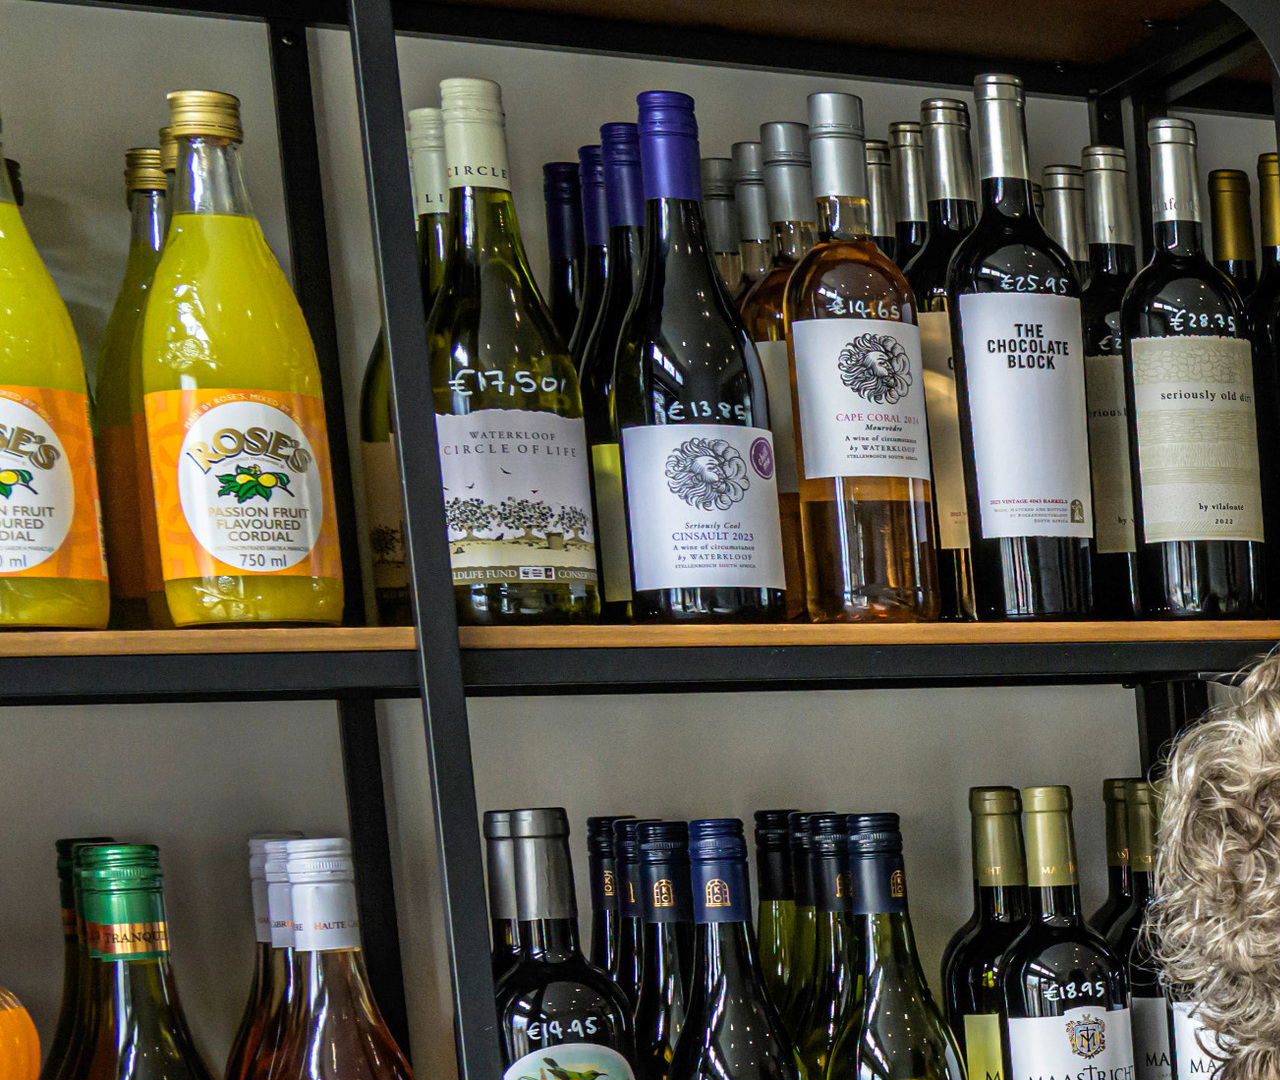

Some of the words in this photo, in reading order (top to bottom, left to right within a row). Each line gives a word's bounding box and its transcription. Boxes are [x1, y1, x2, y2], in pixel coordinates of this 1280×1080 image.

[1014, 323, 1044, 338] THE
[987, 338, 1070, 356] CHOCOLATE
[1007, 354, 1056, 369] BLOCK
[1161, 390, 1217, 401] seriously
[1220, 390, 1237, 401] old
[835, 413, 864, 422] CAPE
[866, 413, 901, 423] CORAL
[469, 430, 556, 442] WATERKLOOF
[186, 427, 312, 475] ROSE'S
[443, 443, 510, 457] CIRCLE
[517, 443, 540, 455] OF
[546, 446, 578, 458] LIFE
[861, 444, 916, 454] WATERKLOOF
[13, 506, 55, 518] FRUIT
[208, 506, 270, 519] PASSION
[272, 507, 309, 519] FRUIT
[1198, 502, 1209, 512] by
[216, 519, 301, 531] FLAVOURED
[684, 521, 721, 531] Seriously
[723, 521, 741, 530] Cool
[228, 531, 294, 543] CORDIAL
[672, 531, 729, 541] CINSAULT
[732, 532, 754, 542] 2023
[710, 543, 755, 552] circumstance
[240, 554, 266, 568] 750
[270, 554, 288, 568] ml
[689, 553, 752, 561] WATERKLOOF
[486, 568, 518, 579] FUND
